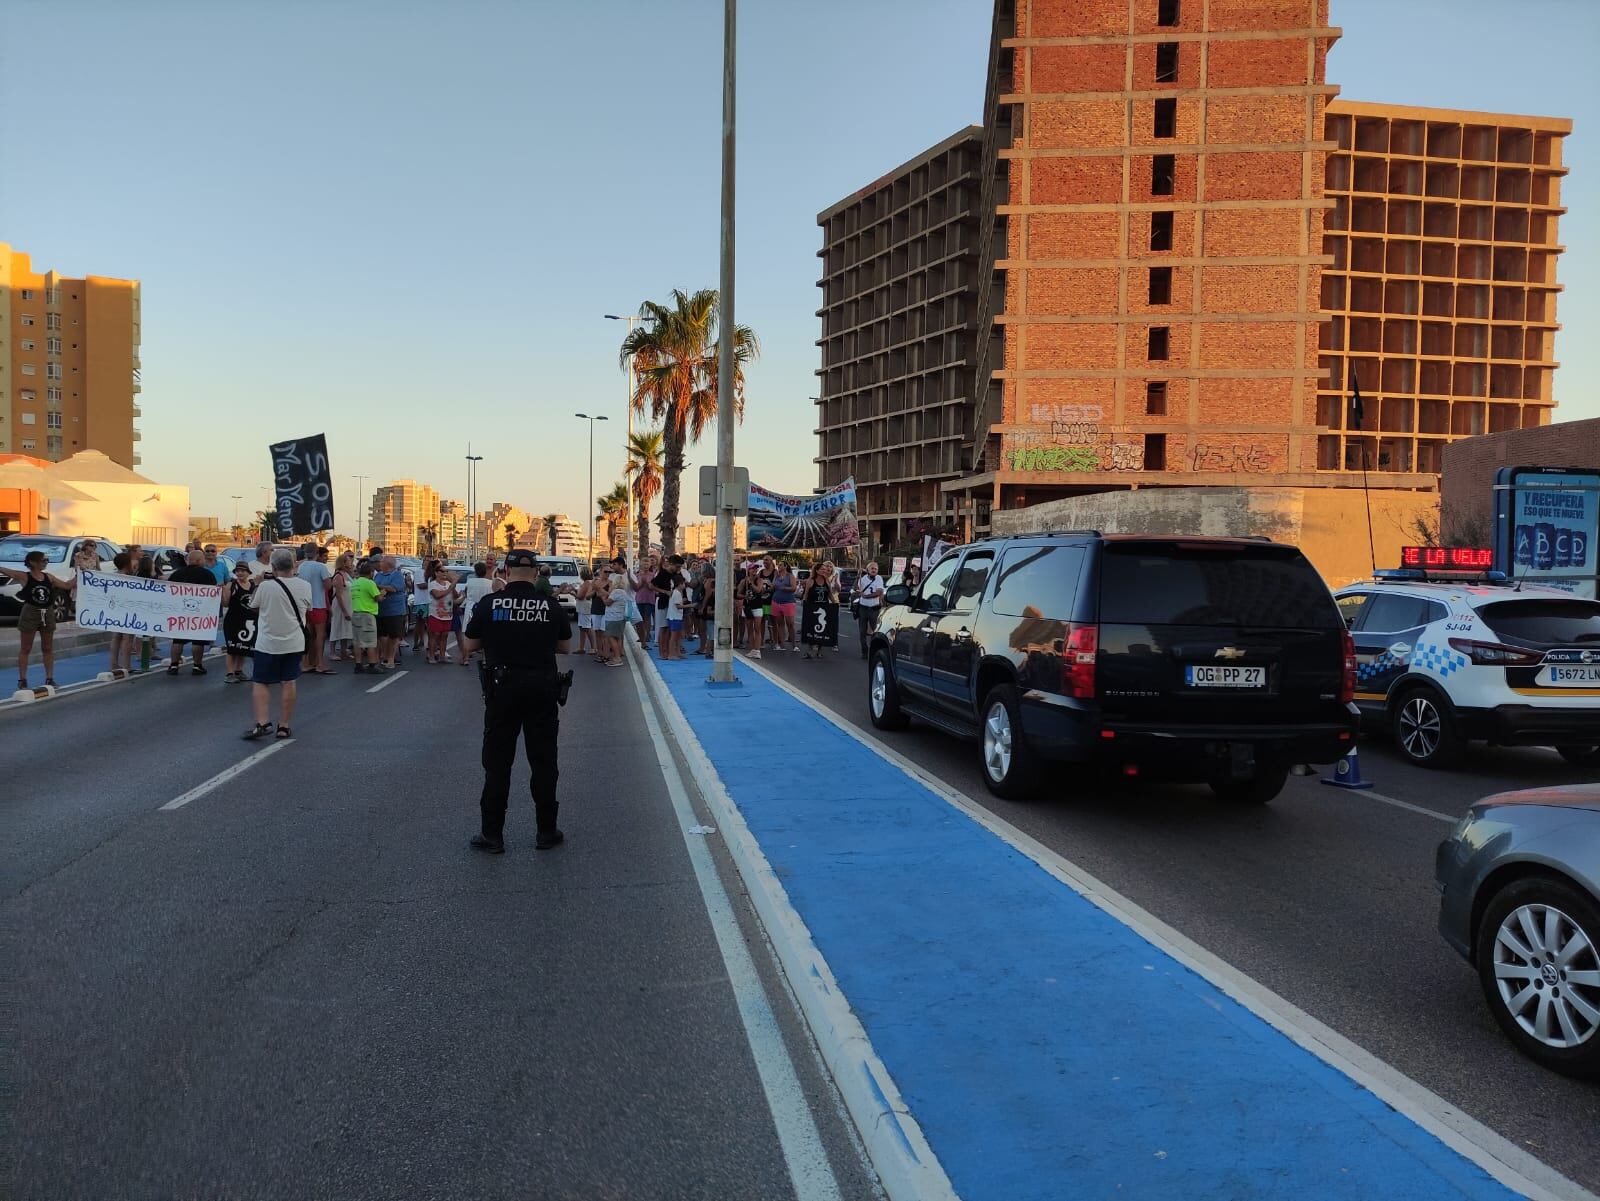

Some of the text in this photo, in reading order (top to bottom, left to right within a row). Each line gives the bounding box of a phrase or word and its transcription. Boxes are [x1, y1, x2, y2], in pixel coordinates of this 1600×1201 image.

[274, 442, 305, 536] Mar Menor
[776, 501, 799, 516] MAR
[803, 494, 848, 516] MENOR
[1532, 492, 1585, 510] RECUPERA
[1524, 506, 1585, 520] ESO QUE TE MUEVE
[1518, 532, 1584, 554] A B C D
[1426, 549, 1445, 564] LA
[82, 570, 167, 594] Responsables
[492, 598, 550, 610] POLICIA
[79, 609, 148, 630] Culpables
[153, 623, 165, 633] a
[510, 609, 551, 622] LOCAL
[1445, 623, 1472, 632] SJ-04
[1196, 667, 1261, 682] OG PP 27
[1558, 668, 1586, 680] 5672
